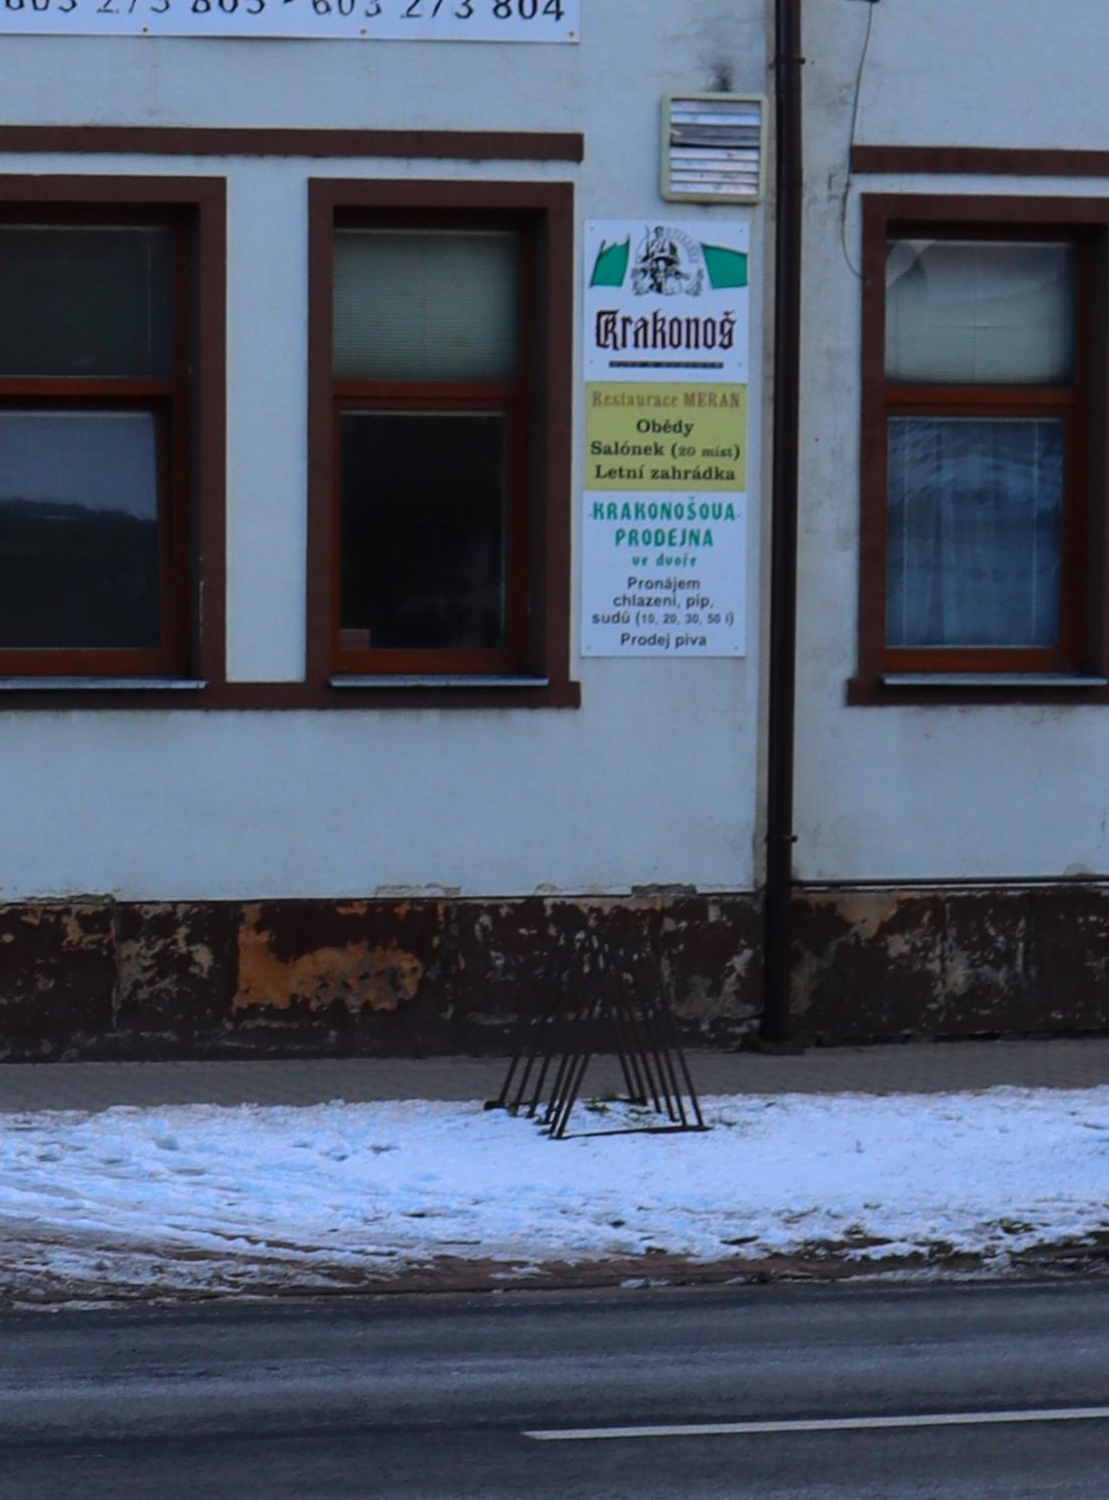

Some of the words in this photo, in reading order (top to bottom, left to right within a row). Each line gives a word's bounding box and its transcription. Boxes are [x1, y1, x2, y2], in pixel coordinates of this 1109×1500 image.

[596, 309, 737, 350] Krakonoš
[593, 390, 679, 407] Restaurace
[684, 392, 740, 408] MERAN
[590, 441, 664, 456] Salónek
[671, 442, 696, 459] (20
[595, 464, 644, 479] Letní
[651, 466, 736, 481] zahrádka
[615, 528, 714, 547] PRODEJNA
[627, 576, 701, 593] Pronájem
[592, 611, 631, 624] sudů
[620, 633, 670, 649] Prodej
[675, 634, 707, 649] piva
